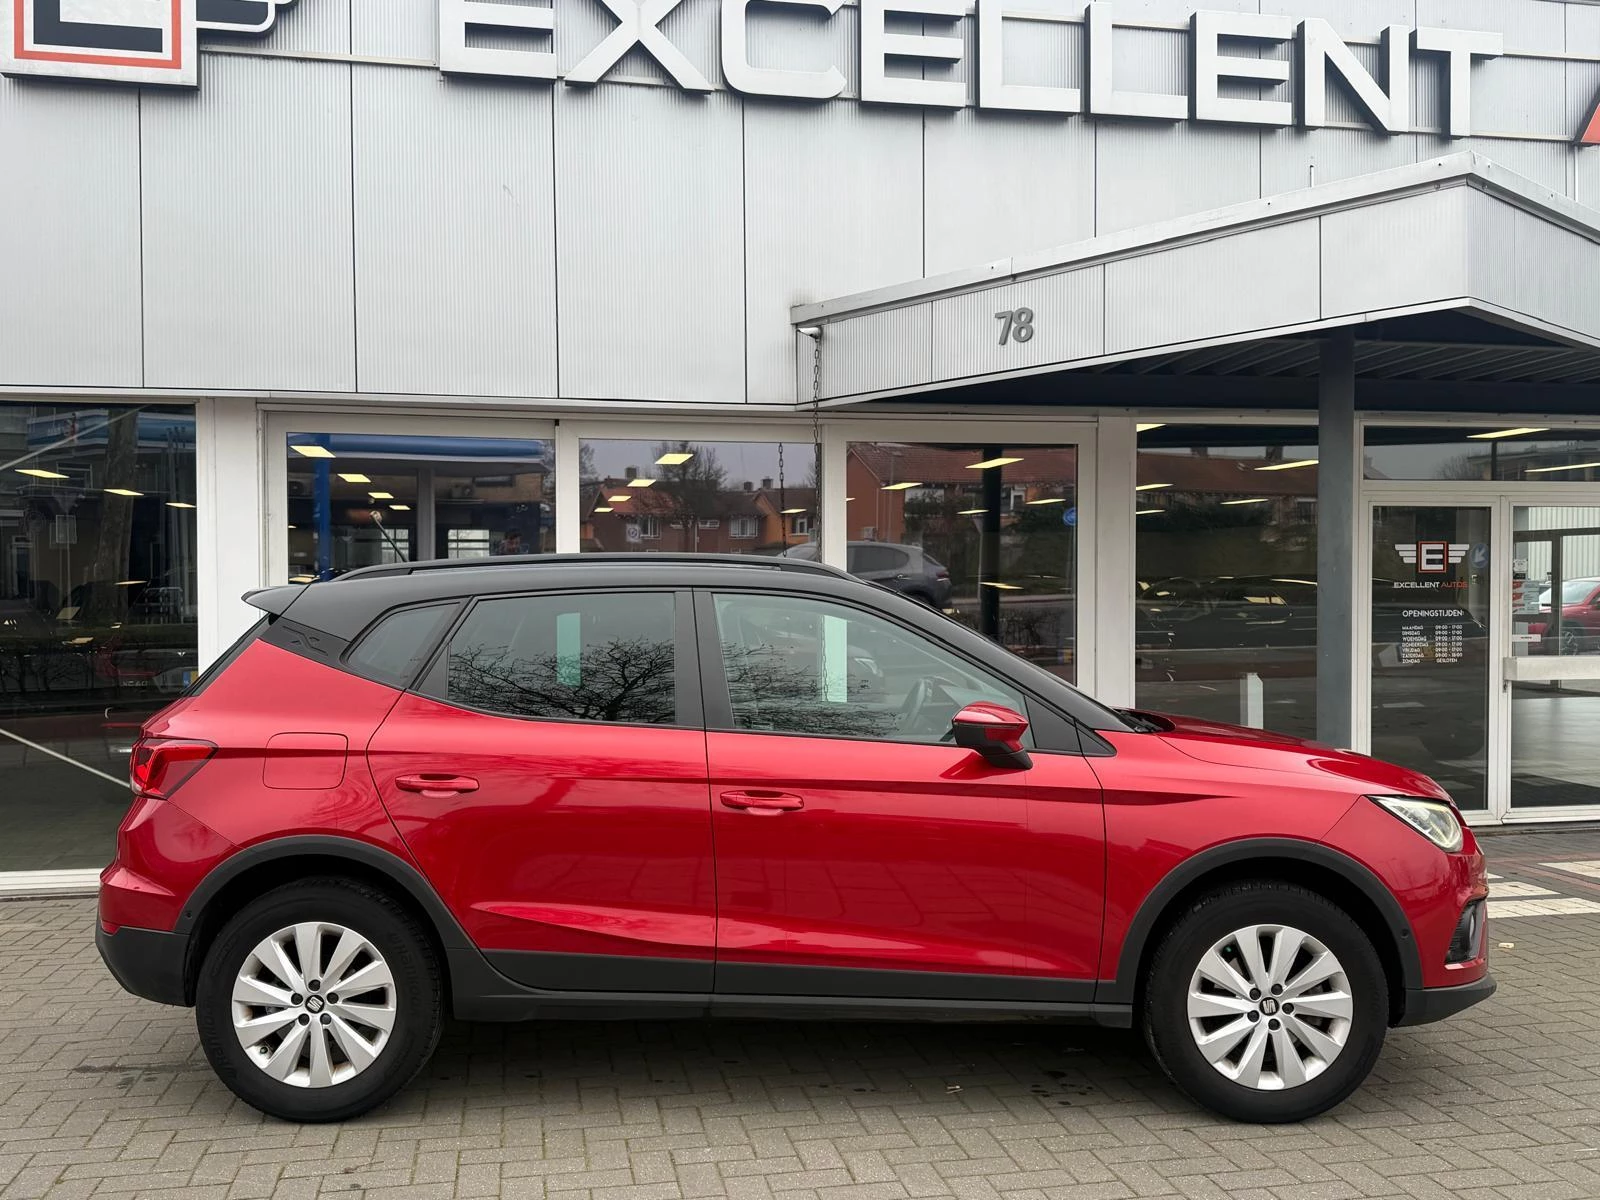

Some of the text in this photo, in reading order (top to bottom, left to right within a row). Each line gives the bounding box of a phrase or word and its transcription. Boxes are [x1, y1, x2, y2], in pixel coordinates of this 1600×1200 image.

[439, 0, 1504, 137] EXCELLENT
[994, 307, 1034, 346] 78
[1421, 543, 1444, 571] E
[1393, 581, 1468, 589] EXCELLENT AUTOS
